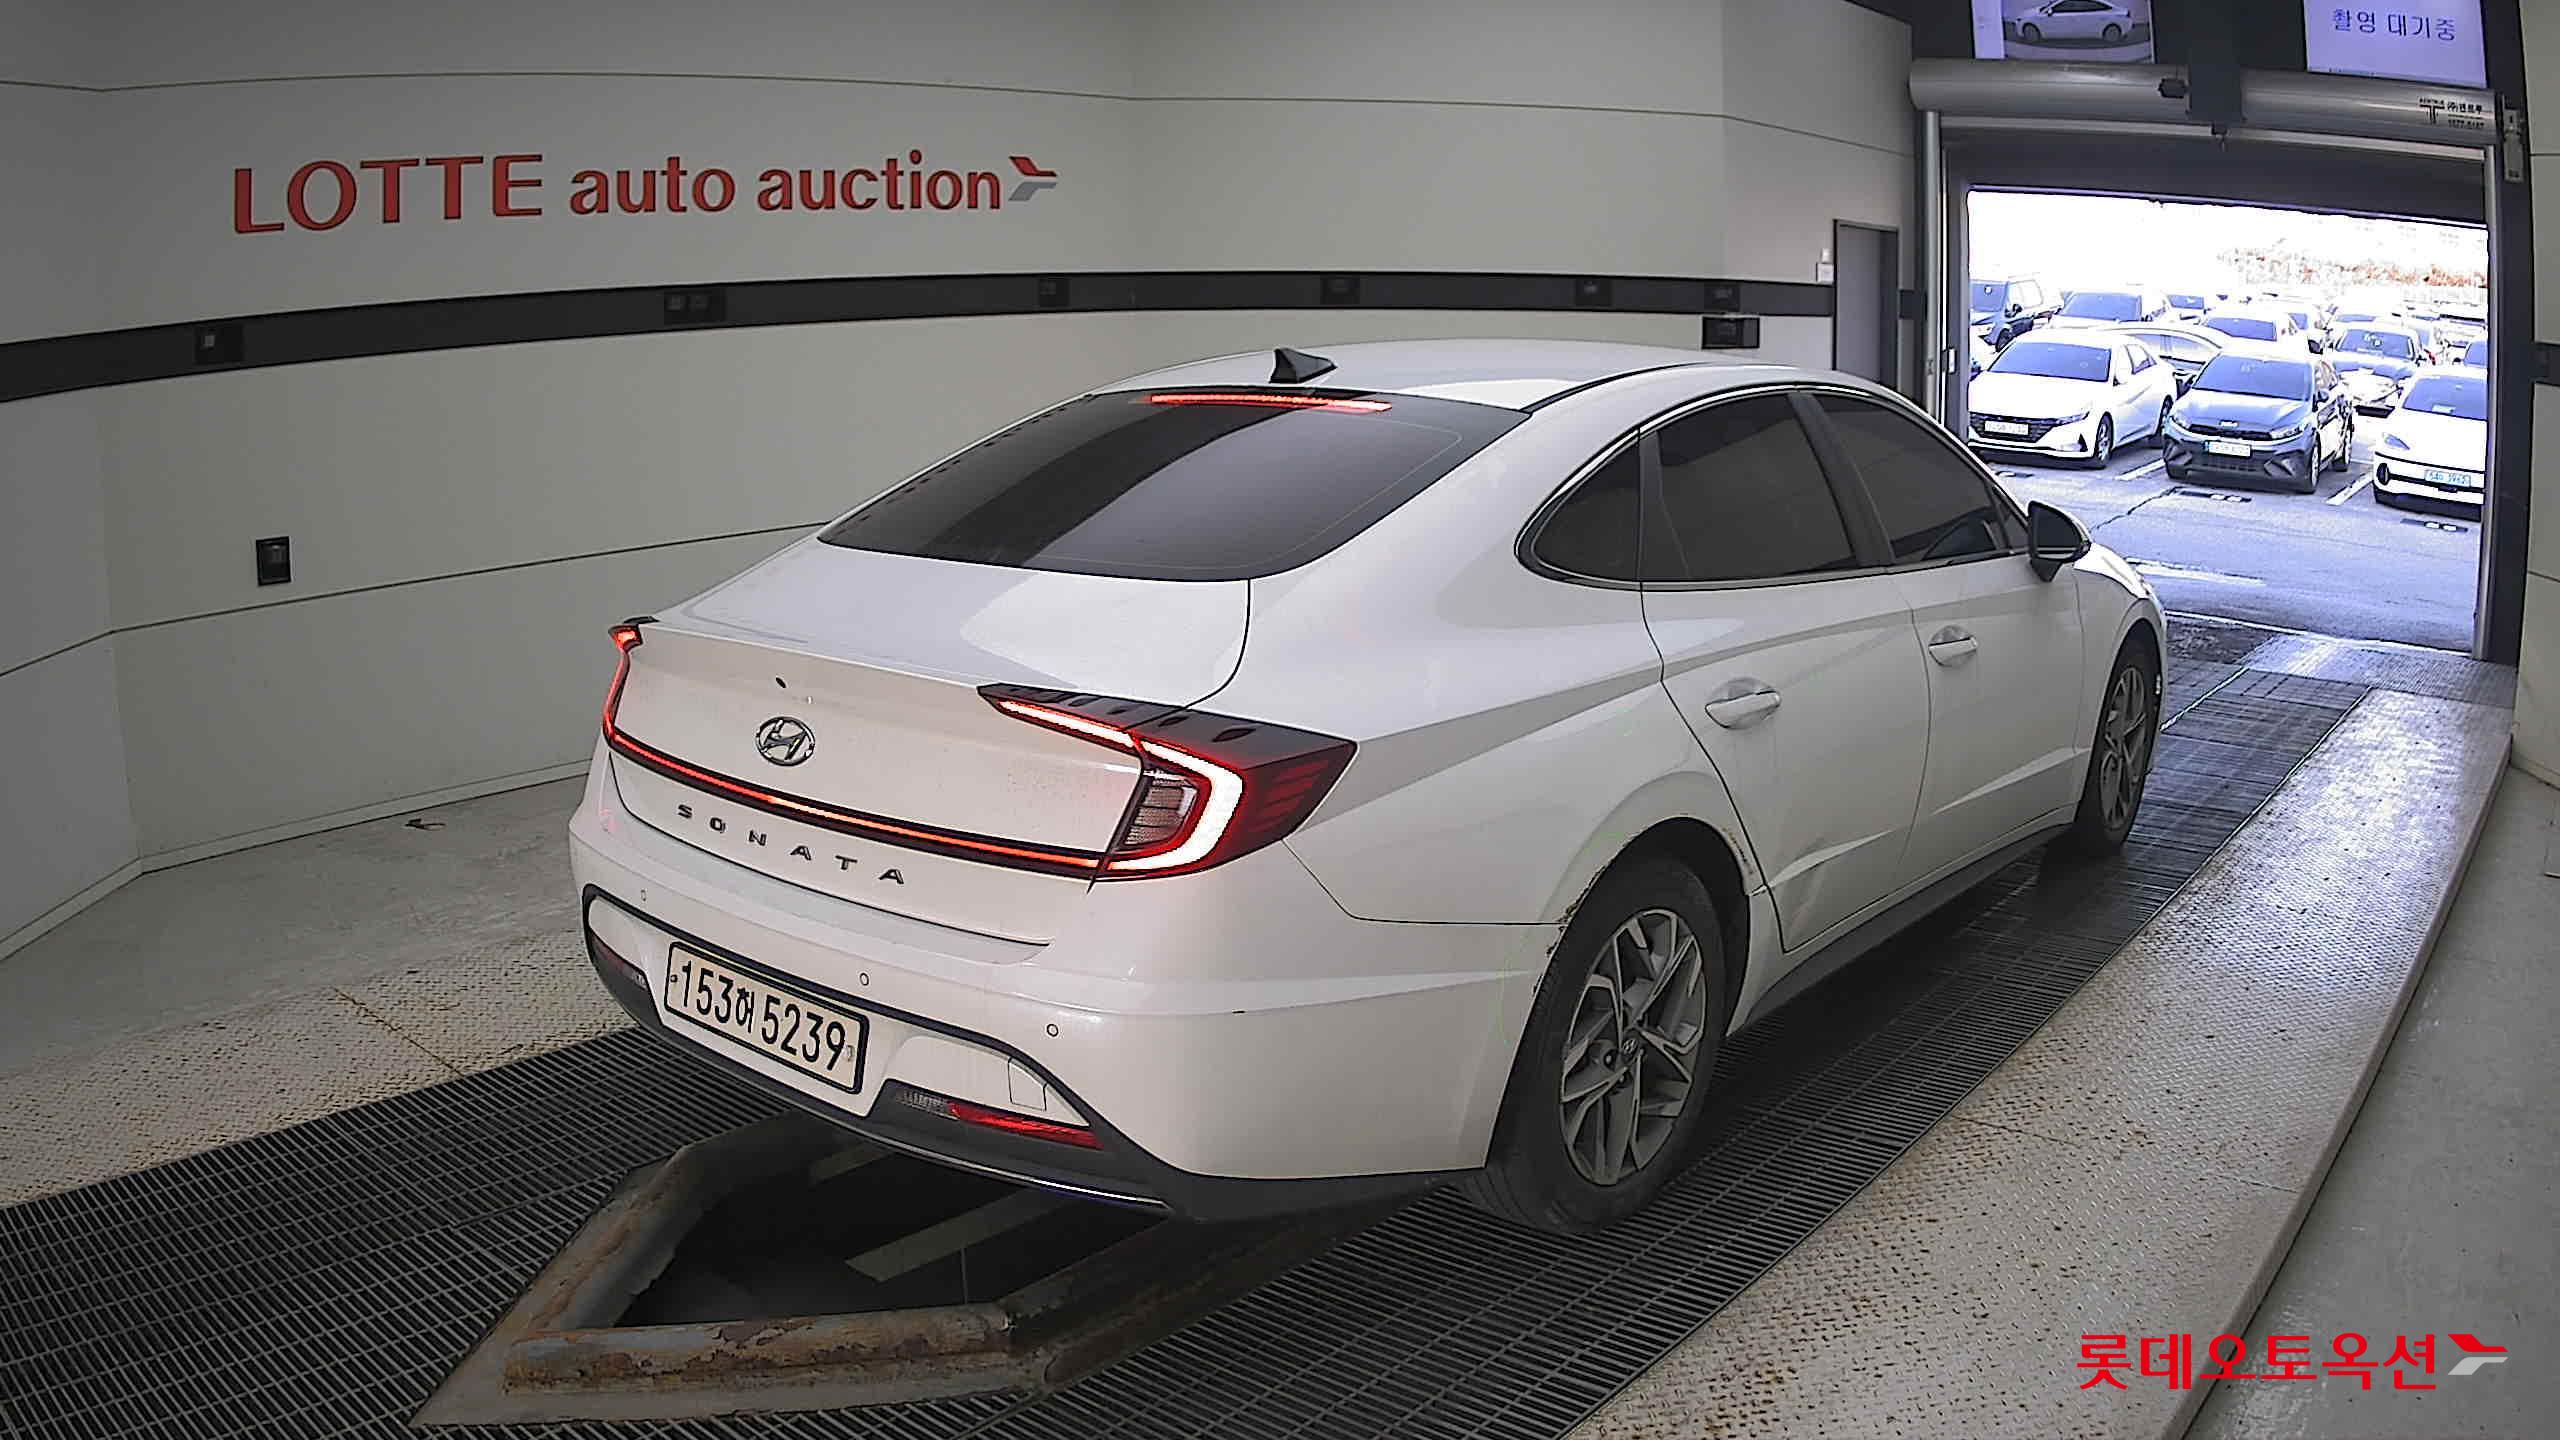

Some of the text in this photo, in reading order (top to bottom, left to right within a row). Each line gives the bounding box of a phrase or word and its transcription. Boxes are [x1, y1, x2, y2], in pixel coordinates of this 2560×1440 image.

[2333, 8, 2376, 33] 촬영
[235, 150, 1001, 232] LOTTE auto auction
[677, 804, 904, 885] SONATA
